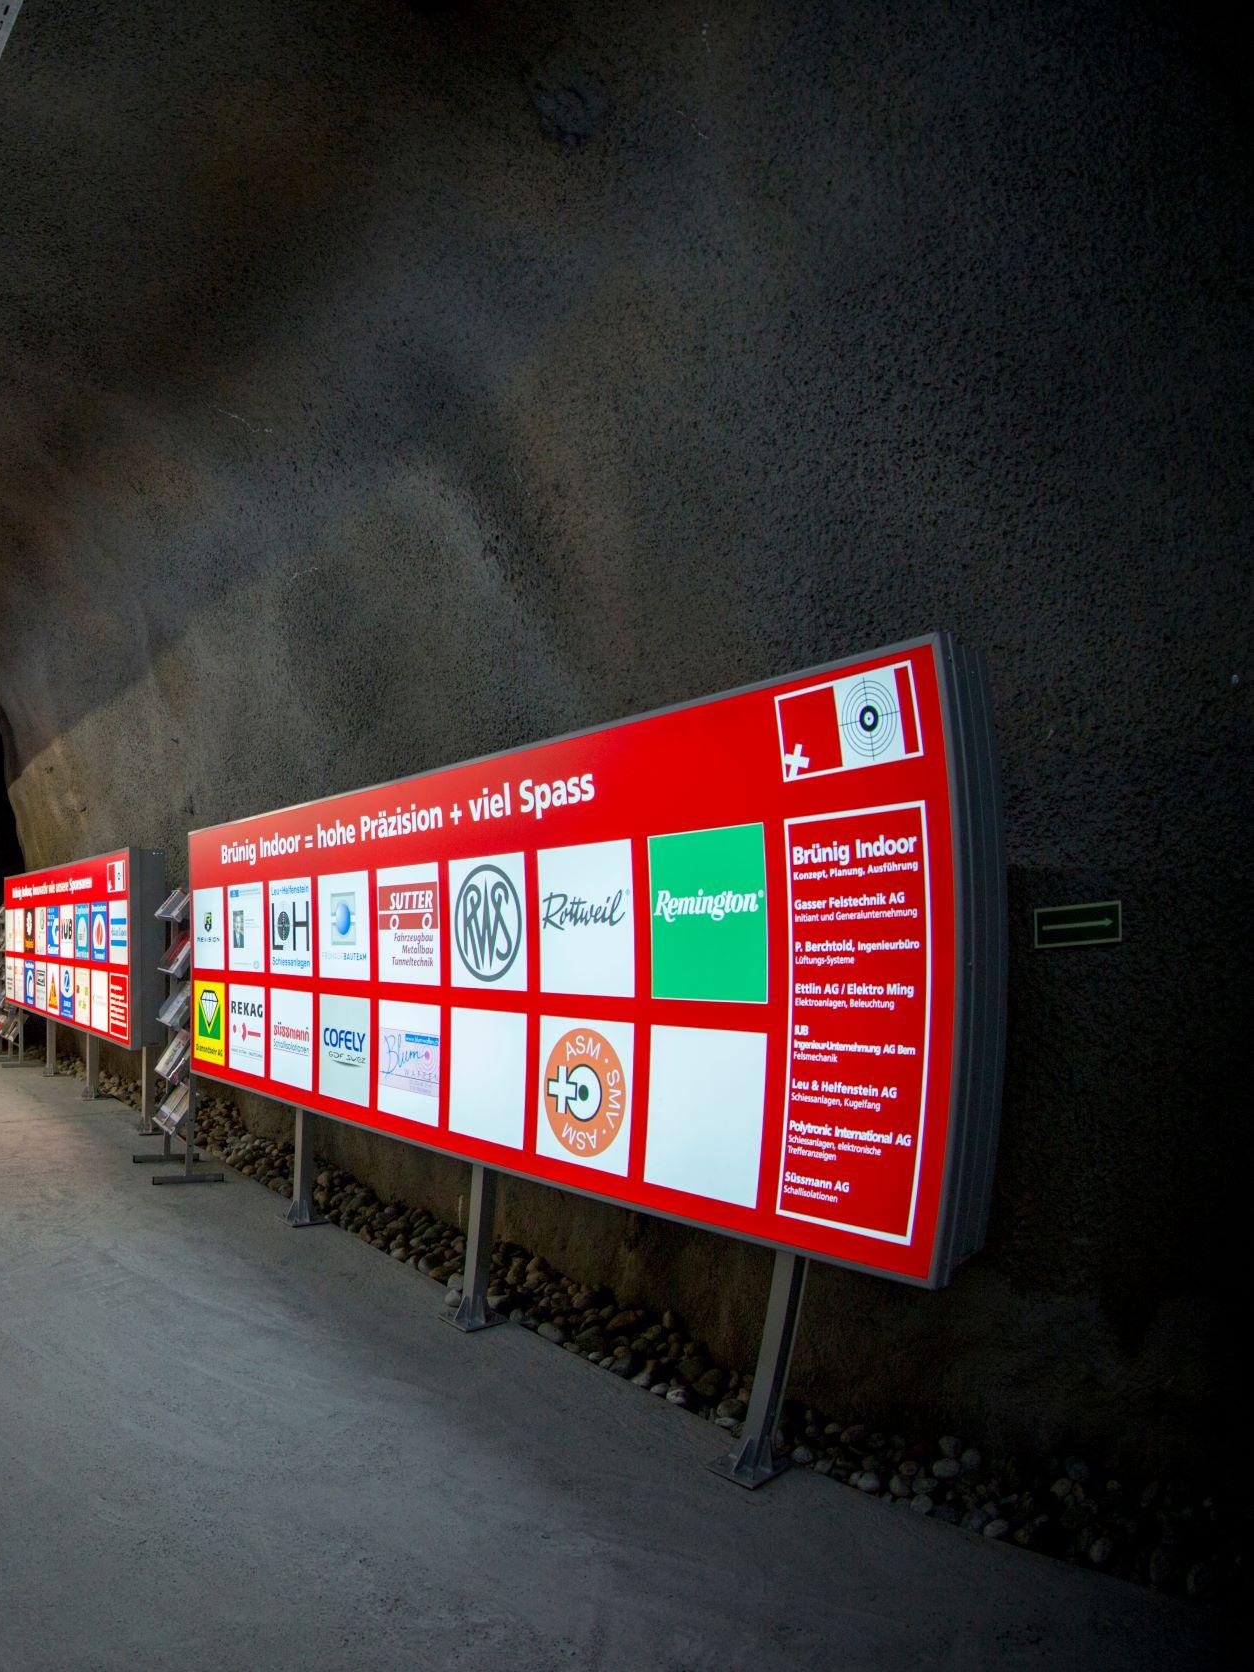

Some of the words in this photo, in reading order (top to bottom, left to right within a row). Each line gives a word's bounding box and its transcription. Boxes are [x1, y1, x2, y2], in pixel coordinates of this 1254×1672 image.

[221, 838, 257, 865] Brünig
[260, 831, 300, 858] Indoor
[317, 822, 355, 848] hohe
[360, 803, 443, 842] Präzision
[469, 782, 511, 822] viel
[520, 772, 595, 819] Spass
[792, 841, 849, 866] Brünig
[855, 835, 917, 859] Indoor
[793, 871, 828, 880] Konzept,
[830, 867, 865, 877] Planung,
[867, 861, 918, 874] Ausführung
[390, 890, 433, 910] SUTTER
[794, 899, 826, 910] Gasser
[829, 893, 886, 908] Felstechnik
[889, 891, 905, 904] AG
[543, 889, 625, 930] Rottweil
[794, 914, 819, 922] Initiant
[821, 912, 834, 921] und
[836, 908, 918, 921] Generalunternehmung
[61, 918, 72, 940] IUB
[463, 875, 513, 970] RWS
[394, 932, 433, 944] Fahrzeugbau
[795, 942, 803, 952] P.
[805, 939, 855, 952] Berchtold,
[858, 939, 920, 953] Ingenieurbüro
[402, 944, 433, 954] Metallbau
[272, 956, 310, 969] Schiessanlagen
[392, 956, 433, 967] Tunneltechnik
[795, 955, 855, 966] Lüftungs-Systeme
[795, 983, 821, 994] Ettlin
[824, 983, 839, 994] AG
[847, 983, 884, 995] Elektro
[886, 983, 914, 998] Ming
[231, 1001, 263, 1018] REKAG
[795, 998, 848, 1009] Elektroanlagen,
[850, 998, 895, 1010] Beleuchtung
[794, 1025, 809, 1035] IUB
[323, 1027, 365, 1052] COFELY
[566, 1035, 601, 1061] ASM
[382, 1033, 424, 1074] Blum
[793, 1052, 838, 1062] Felsmechanik
[883, 1044, 895, 1054] AG
[897, 1045, 916, 1055] Bern
[792, 1078, 809, 1090] Leu
[811, 1080, 819, 1091] &
[821, 1081, 878, 1097] Helfenstein
[881, 1087, 897, 1098] AG
[791, 1092, 842, 1107] Schiessanlagen,
[844, 1098, 881, 1112] Kugelfang
[562, 1122, 597, 1150] ASM
[789, 1120, 832, 1136] Polytronic
[834, 1126, 893, 1144] International
[895, 1134, 912, 1147] AG
[788, 1145, 837, 1161] Trefferanzeigen
[837, 1142, 882, 1156] elektronische
[785, 1171, 832, 1190] Süssmann
[834, 1181, 850, 1193] AG
[784, 1185, 838, 1203] Schallisolationen
